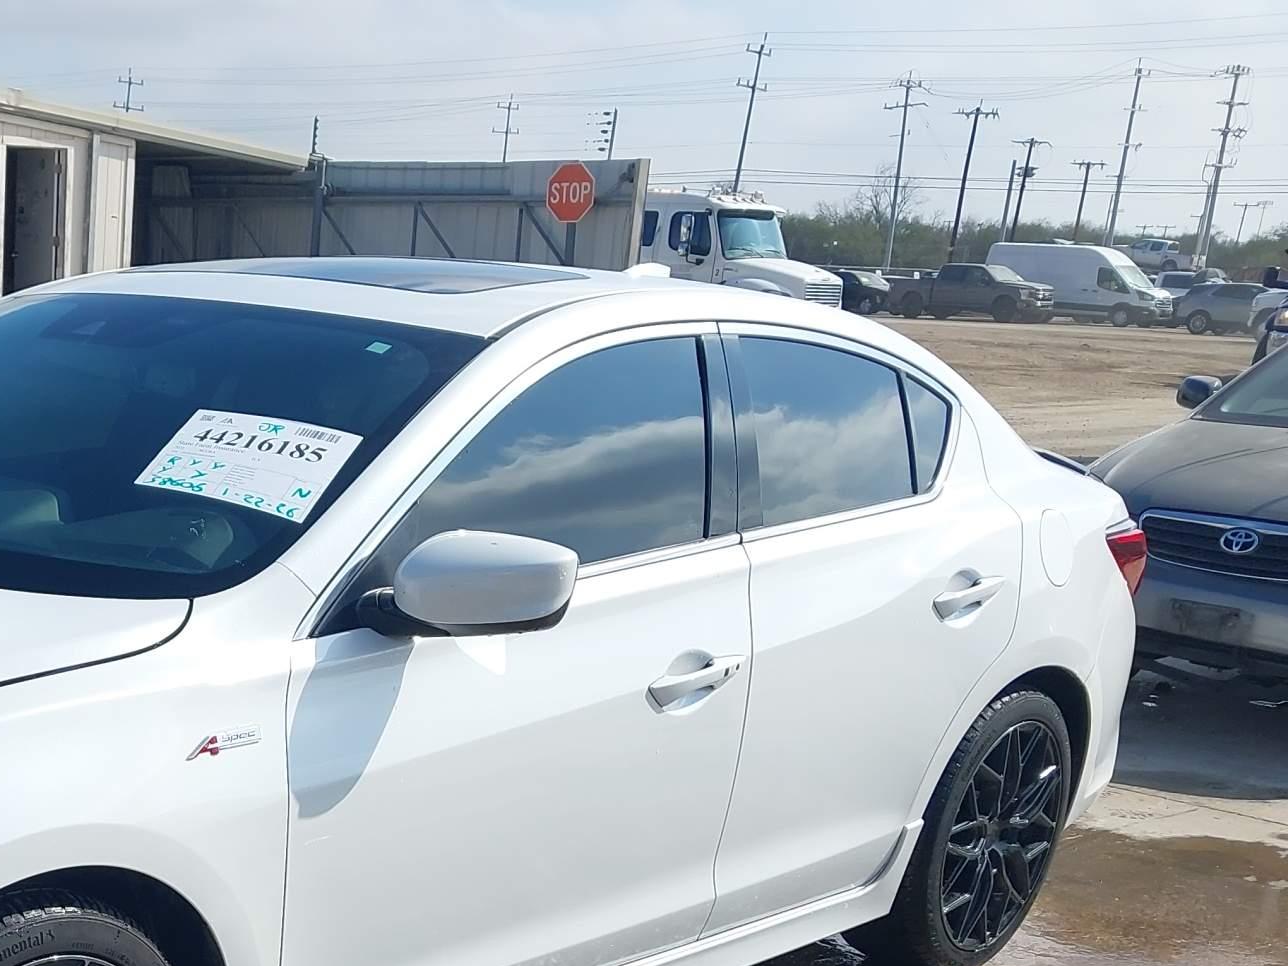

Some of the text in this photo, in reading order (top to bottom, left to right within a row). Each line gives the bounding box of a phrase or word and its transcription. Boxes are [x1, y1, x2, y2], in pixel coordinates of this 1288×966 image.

[550, 182, 591, 204] STOP
[193, 428, 328, 463] 44216185
[291, 487, 312, 498] N
